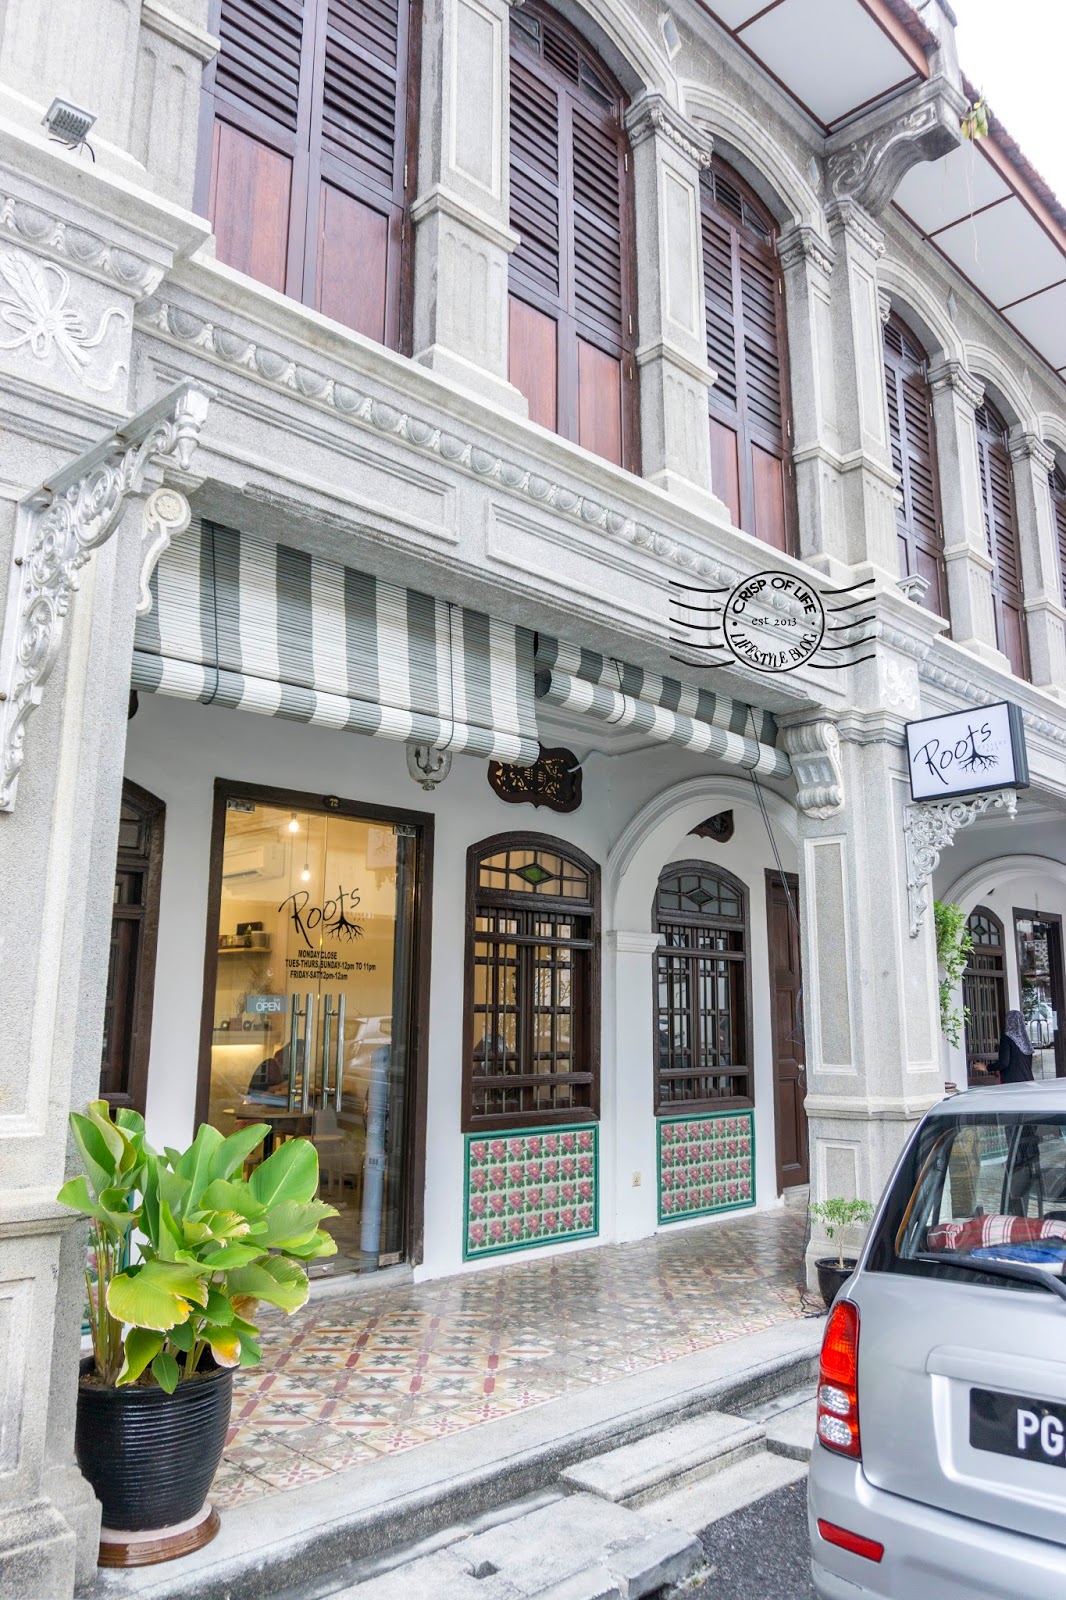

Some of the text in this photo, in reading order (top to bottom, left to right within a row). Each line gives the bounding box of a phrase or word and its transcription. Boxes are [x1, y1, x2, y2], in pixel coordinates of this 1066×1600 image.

[913, 722, 996, 785] Roots
[278, 885, 364, 949] Roots
[298, 950, 337, 959] MONDAY CLOSE
[356, 962, 363, 970] TO
[363, 963, 376, 972] 11pm
[256, 1002, 281, 1011] OPEN
[1017, 1409, 1066, 1459] PG
